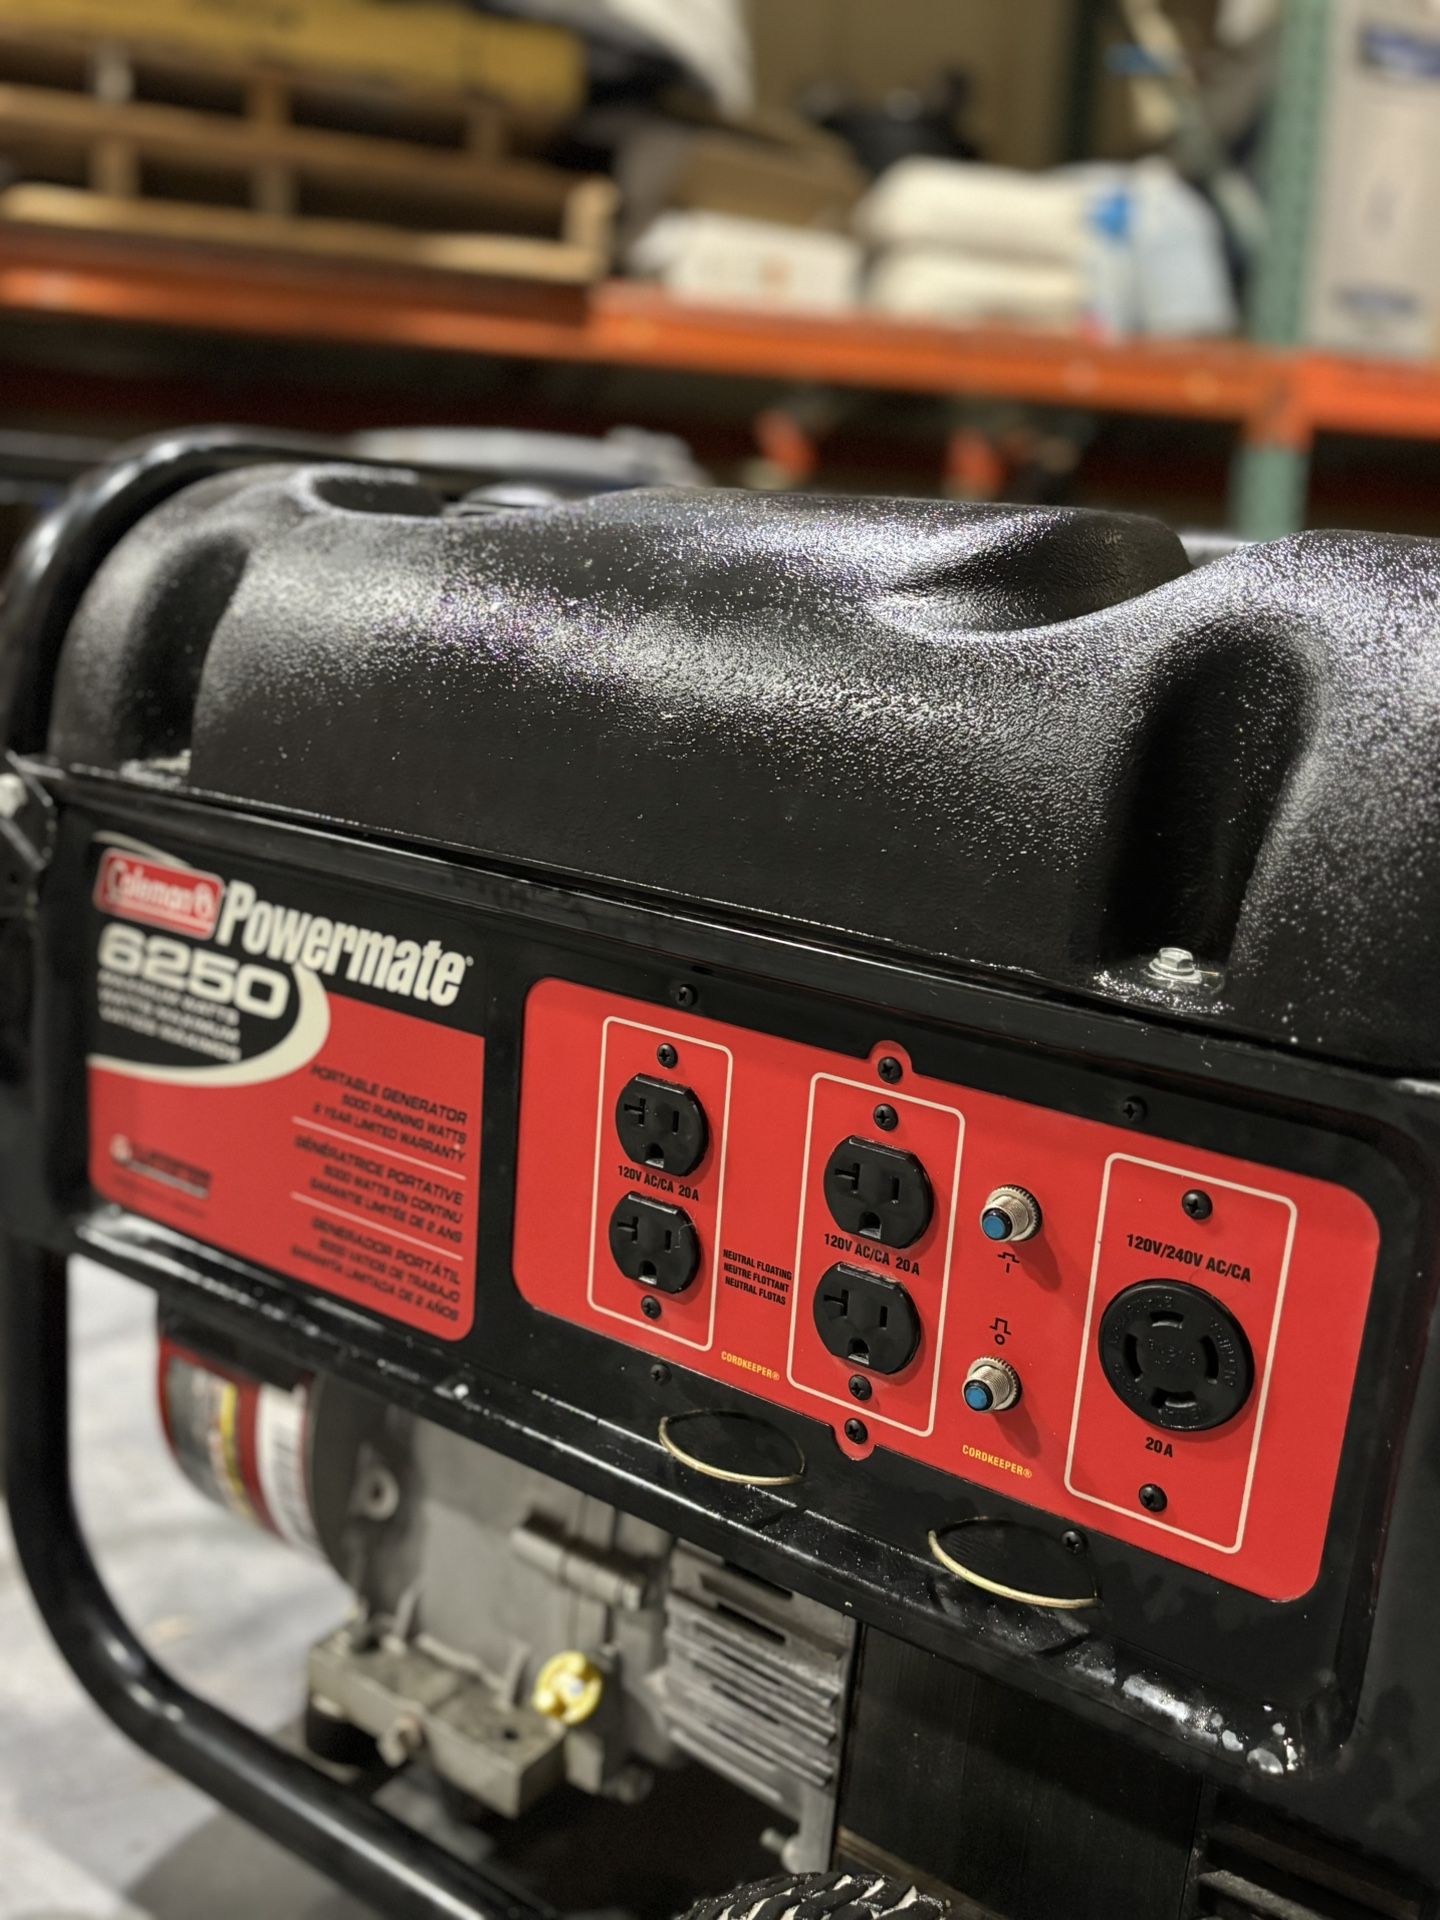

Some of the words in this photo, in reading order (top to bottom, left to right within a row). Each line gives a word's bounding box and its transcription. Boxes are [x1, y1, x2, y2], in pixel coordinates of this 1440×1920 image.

[97, 922, 291, 1020] 6250
[311, 1065, 379, 1096] PORTABLE
[383, 1088, 466, 1124] GENERATOR
[374, 1103, 424, 1130] RUNNING
[428, 1121, 466, 1144] WATTS
[400, 1134, 465, 1162] WARRANTY
[388, 1168, 462, 1205] PORTATIVE
[618, 1165, 642, 1182] 120V
[643, 1175, 674, 1193] AC/CA
[411, 1196, 462, 1224] CONTINU
[723, 1248, 756, 1268] NEUTRAL
[757, 1260, 792, 1281] FLOATING
[824, 1233, 853, 1252] 120V
[854, 1243, 890, 1266] AC/CA
[1127, 1233, 1203, 1267] 120V/240V
[1206, 1256, 1251, 1282] AC/CA
[723, 1262, 752, 1280] NEUTRE
[753, 1272, 790, 1293] FLOTTANT
[725, 1275, 758, 1295] NEUTRAL
[759, 1287, 786, 1306] FLOTAS
